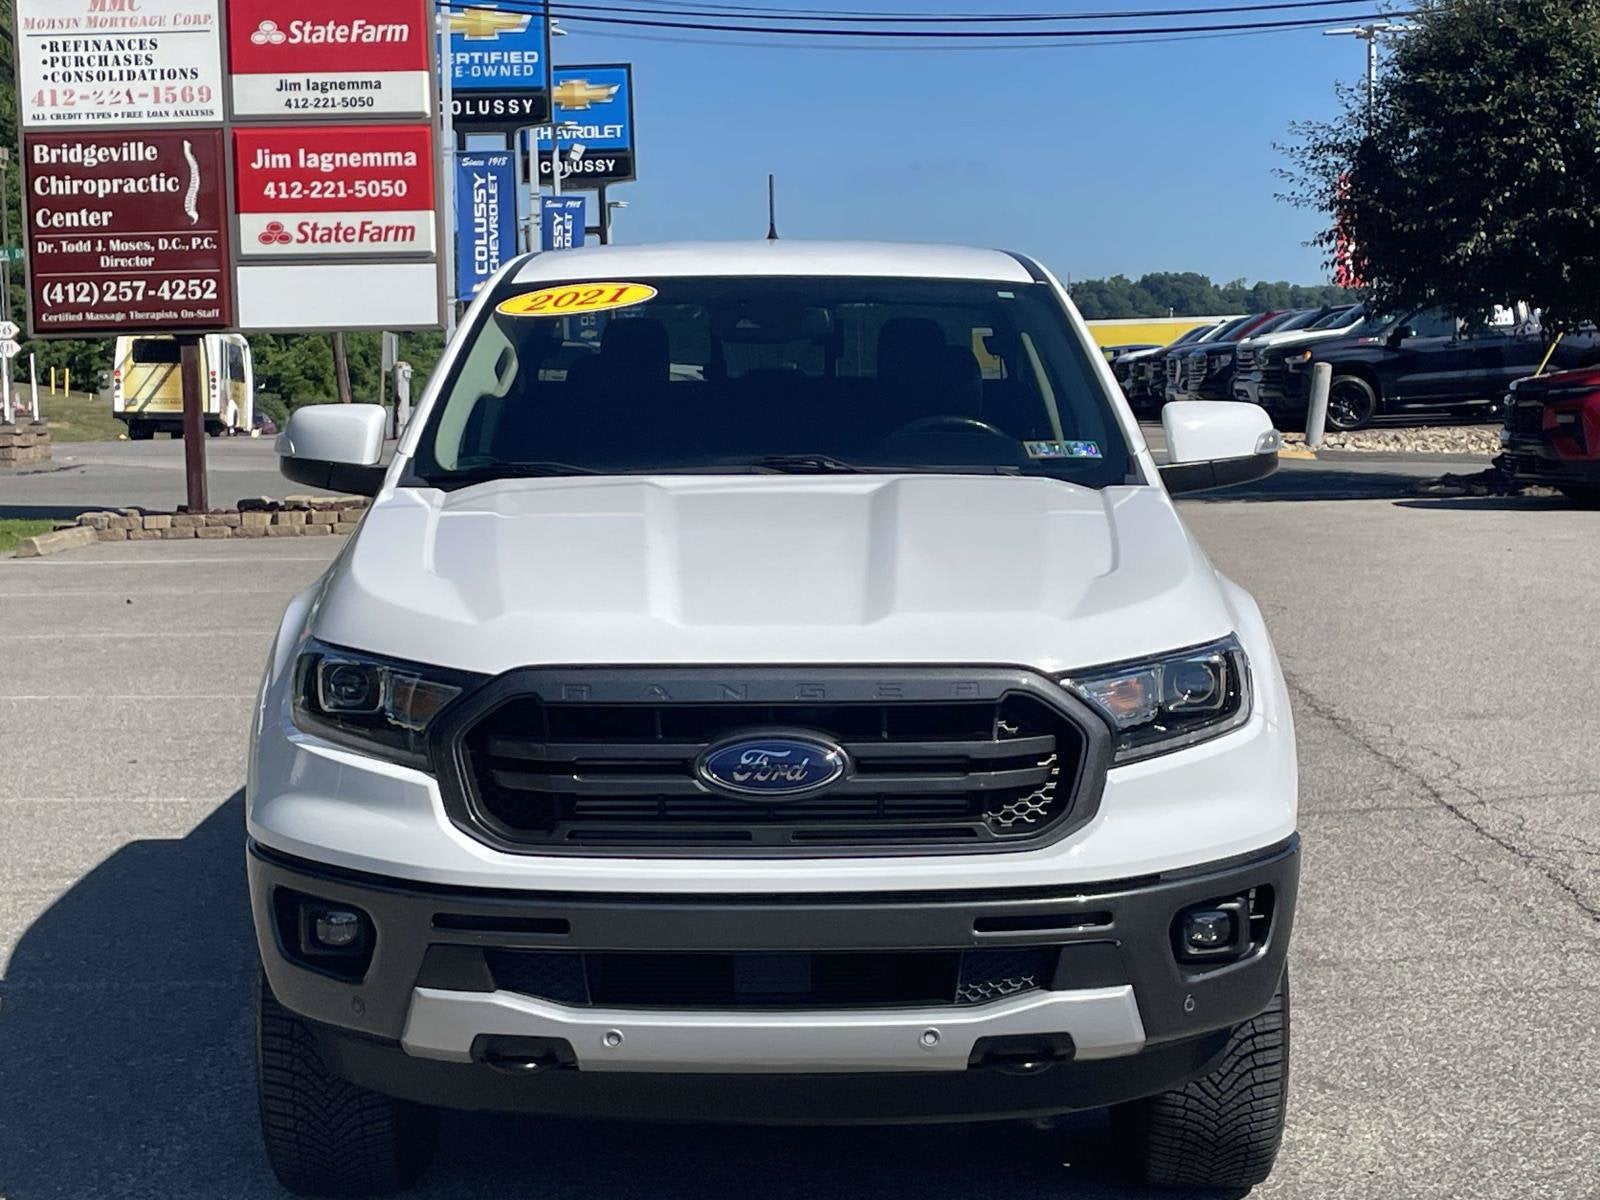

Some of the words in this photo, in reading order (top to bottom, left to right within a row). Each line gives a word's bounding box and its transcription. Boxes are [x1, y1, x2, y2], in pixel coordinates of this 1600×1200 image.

[49, 38, 158, 53] REFINANCES
[50, 53, 154, 68] PURCHASES
[51, 67, 199, 83] CONSOLIDATIONS
[276, 79, 301, 92] Jim
[31, 85, 212, 107] 412-221-1569
[284, 96, 374, 109] 412-221-5050
[31, 113, 47, 121] ALL
[50, 112, 82, 121] CREDIT
[84, 112, 112, 120] TYPES
[121, 111, 143, 119] FREE
[147, 110, 170, 118] LOAN
[171, 109, 215, 118] ANALYSIS
[33, 142, 158, 167] Bridgeville
[251, 148, 291, 169] Jim
[298, 148, 417, 172] Iagnemma
[34, 172, 180, 198] Chiropractic
[263, 180, 407, 199] 412-221-5050
[35, 208, 113, 228] Center
[473, 172, 488, 275] COLUSSY
[487, 172, 500, 274] CHEVROLET
[37, 241, 58, 254] Dr.
[60, 240, 91, 253] Todd
[95, 239, 106, 252] J.
[109, 239, 155, 253] Moses,
[192, 237, 217, 250] P.C.
[100, 256, 155, 268] Director
[102, 278, 217, 301] 257-4252
[522, 286, 629, 312] 2021
[42, 312, 82, 322] Certified
[85, 311, 126, 322] Massage
[129, 310, 178, 321] Therapists
[180, 308, 219, 319] On-Staff
[733, 749, 810, 781] Ford
